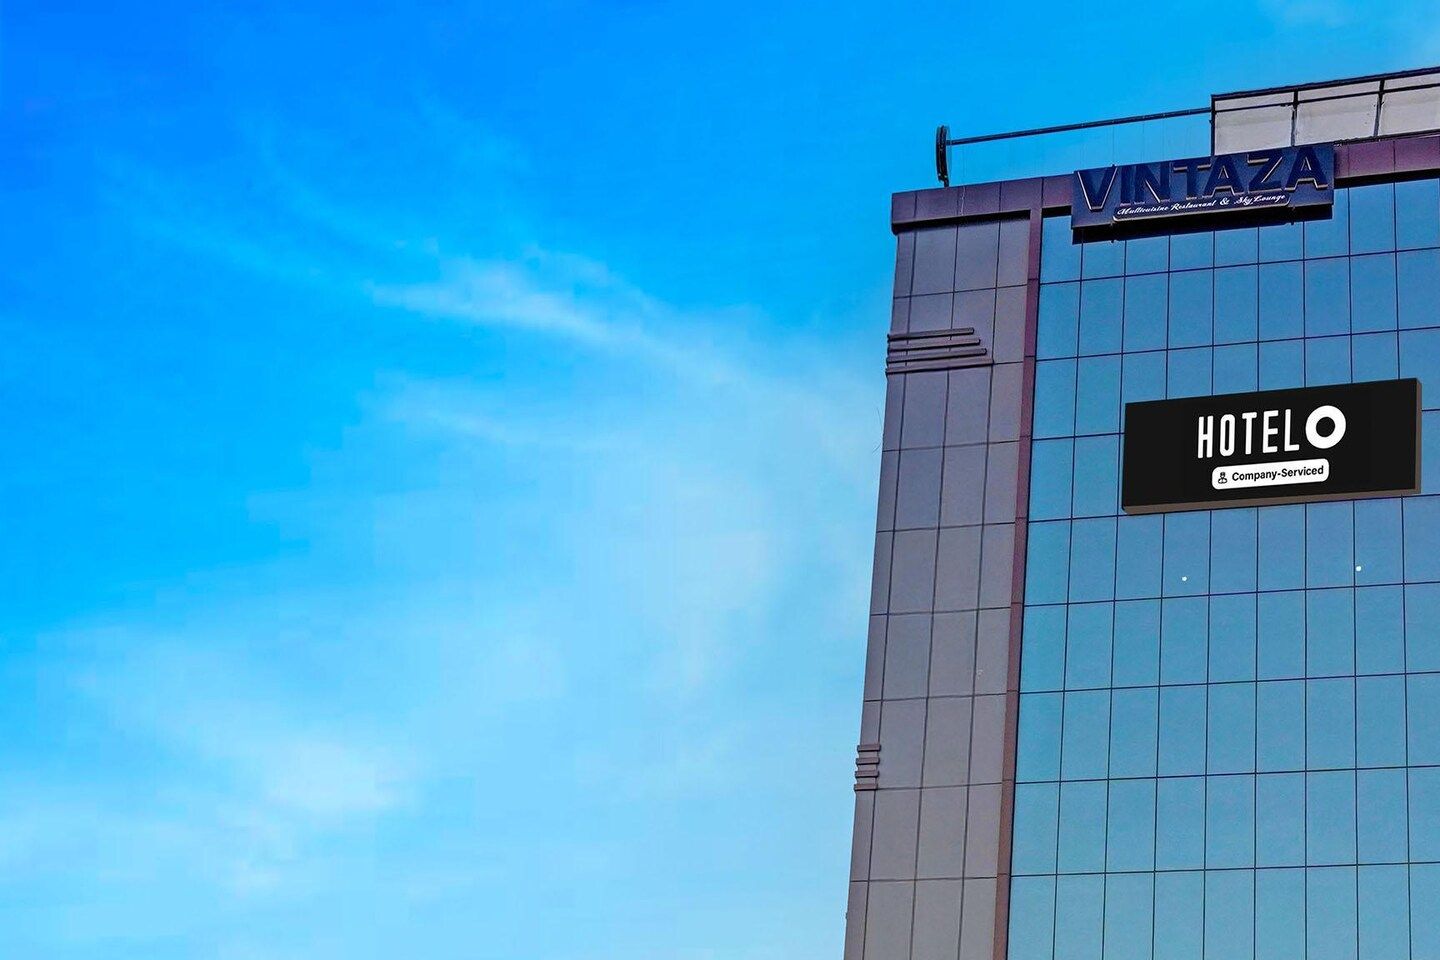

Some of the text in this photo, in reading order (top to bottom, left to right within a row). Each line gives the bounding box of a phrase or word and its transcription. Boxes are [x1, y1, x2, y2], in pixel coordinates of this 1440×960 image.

[1076, 146, 1328, 210] VINTAZA
[1117, 204, 1169, 216] Multicuisine
[1170, 198, 1217, 211] Restaurant
[1219, 196, 1230, 206] &
[1197, 408, 1300, 459] HOTEL
[1232, 465, 1324, 483] Company-Serviced
